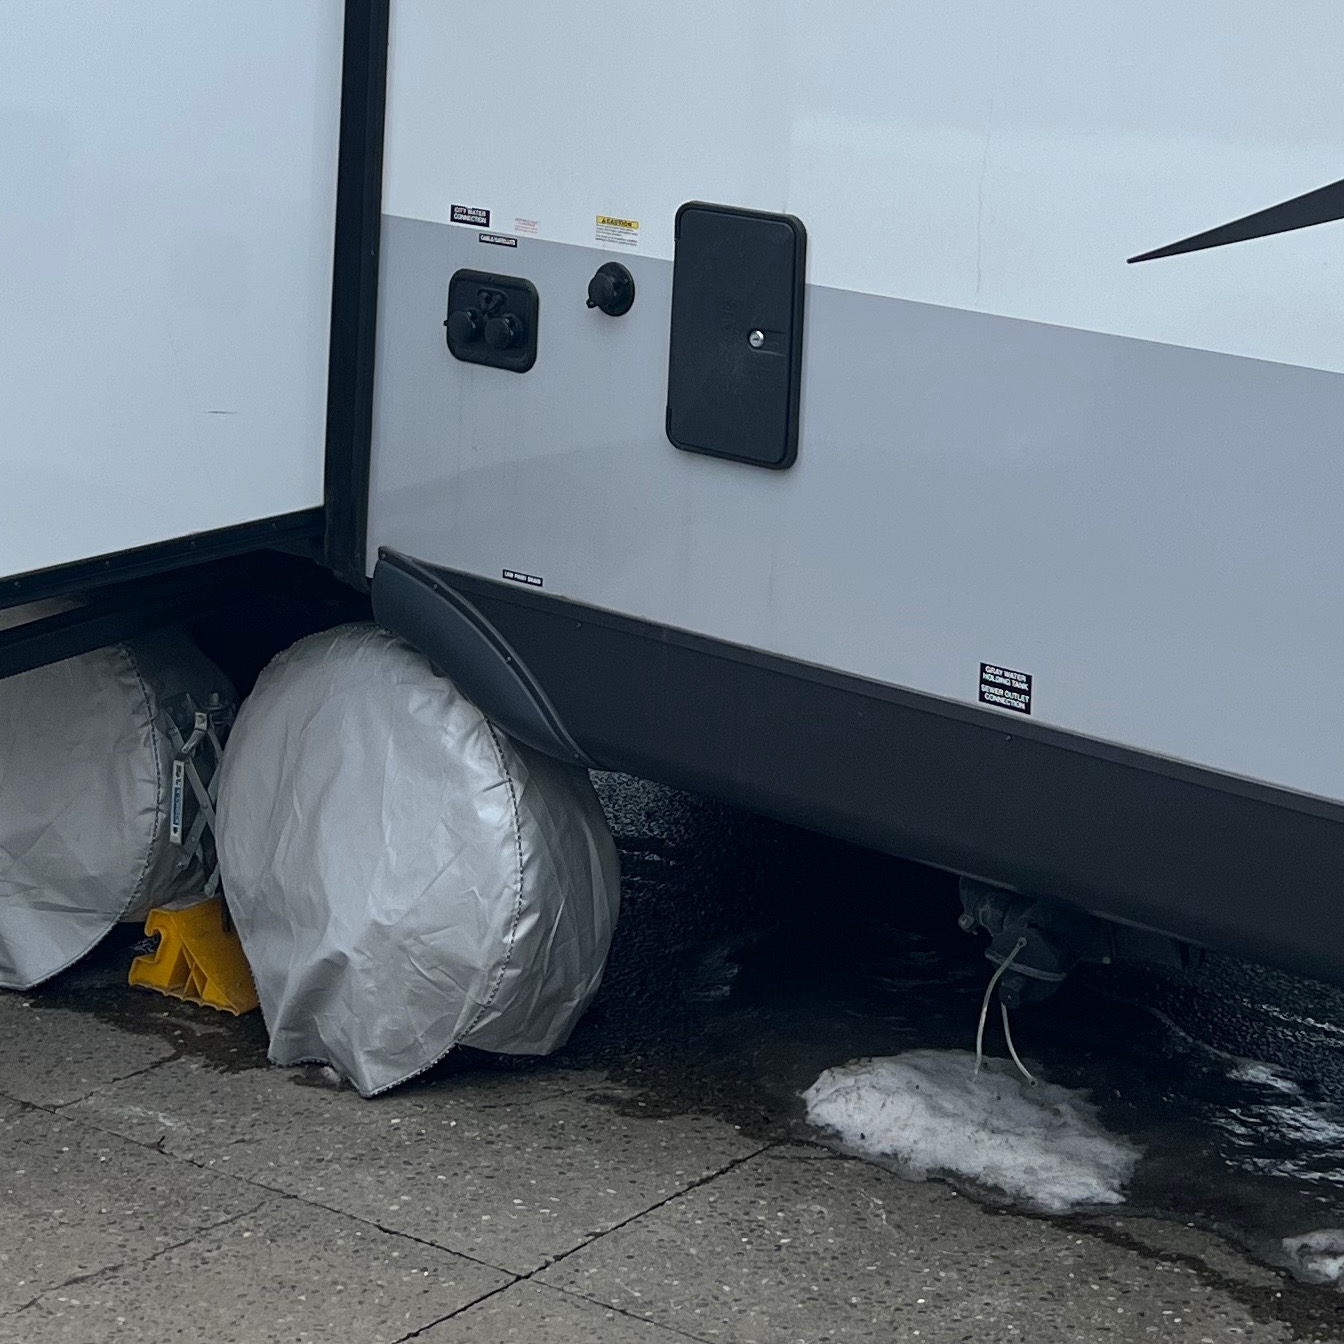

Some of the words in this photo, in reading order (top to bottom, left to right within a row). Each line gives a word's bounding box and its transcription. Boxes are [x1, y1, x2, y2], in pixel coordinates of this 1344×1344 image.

[982, 672, 1011, 686] HOLDING
[1012, 680, 1029, 691] TANK
[1004, 671, 1026, 682] WATER
[981, 684, 1004, 696] SEWER
[1004, 690, 1030, 703] OUTLET
[984, 693, 1026, 710] CONNECTION
